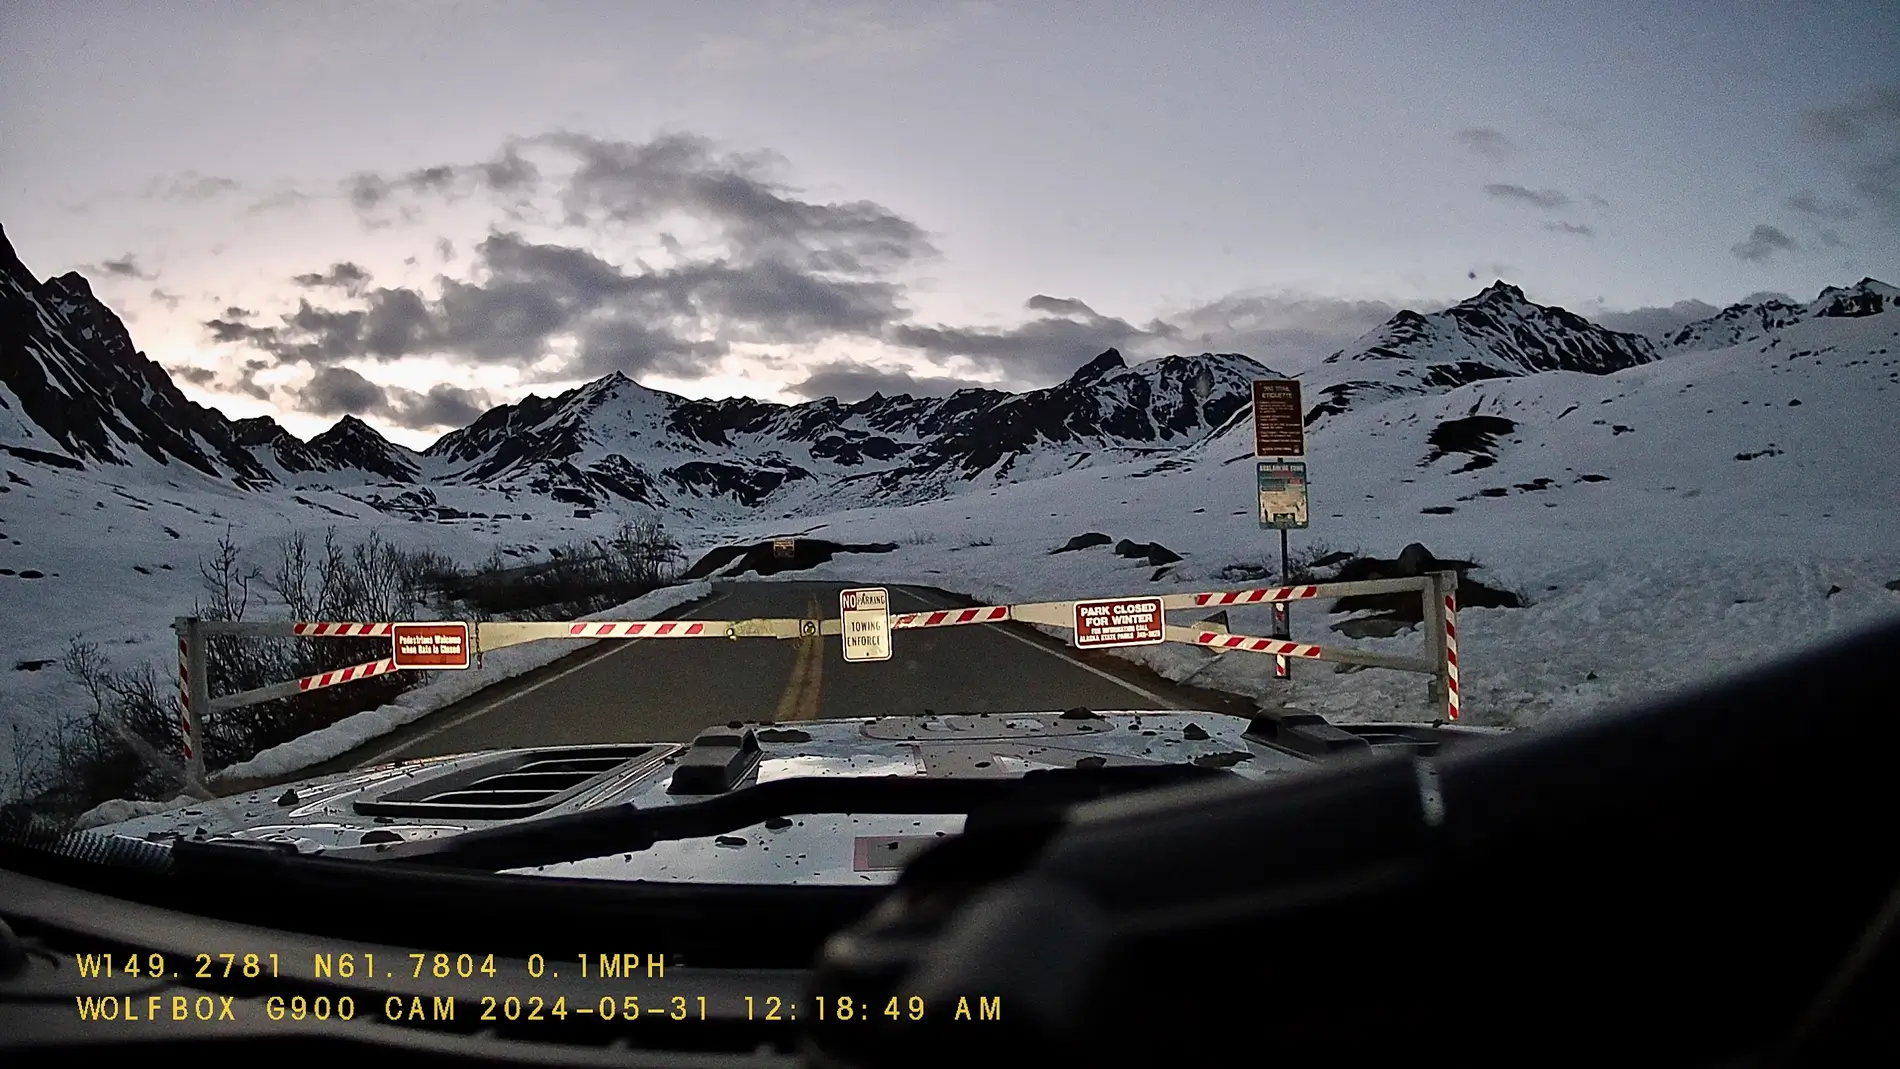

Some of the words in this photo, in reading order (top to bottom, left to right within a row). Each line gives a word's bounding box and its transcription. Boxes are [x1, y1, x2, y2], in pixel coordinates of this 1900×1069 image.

[843, 594, 857, 609] NO
[857, 595, 885, 605] PARKING
[1080, 605, 1110, 617] PARK
[1113, 603, 1157, 614] CLOSED
[1085, 616, 1109, 627] FOR
[1111, 613, 1153, 625] WINTER
[851, 621, 881, 632] TOWING
[1091, 627, 1101, 635] FOR
[1136, 623, 1149, 631] CALL
[399, 634, 433, 645] Pedestrians
[434, 634, 461, 645] Welcome
[1079, 634, 1100, 643] ALASKA
[401, 644, 417, 654] when
[418, 644, 432, 654] Gate
[440, 644, 461, 654] Closed
